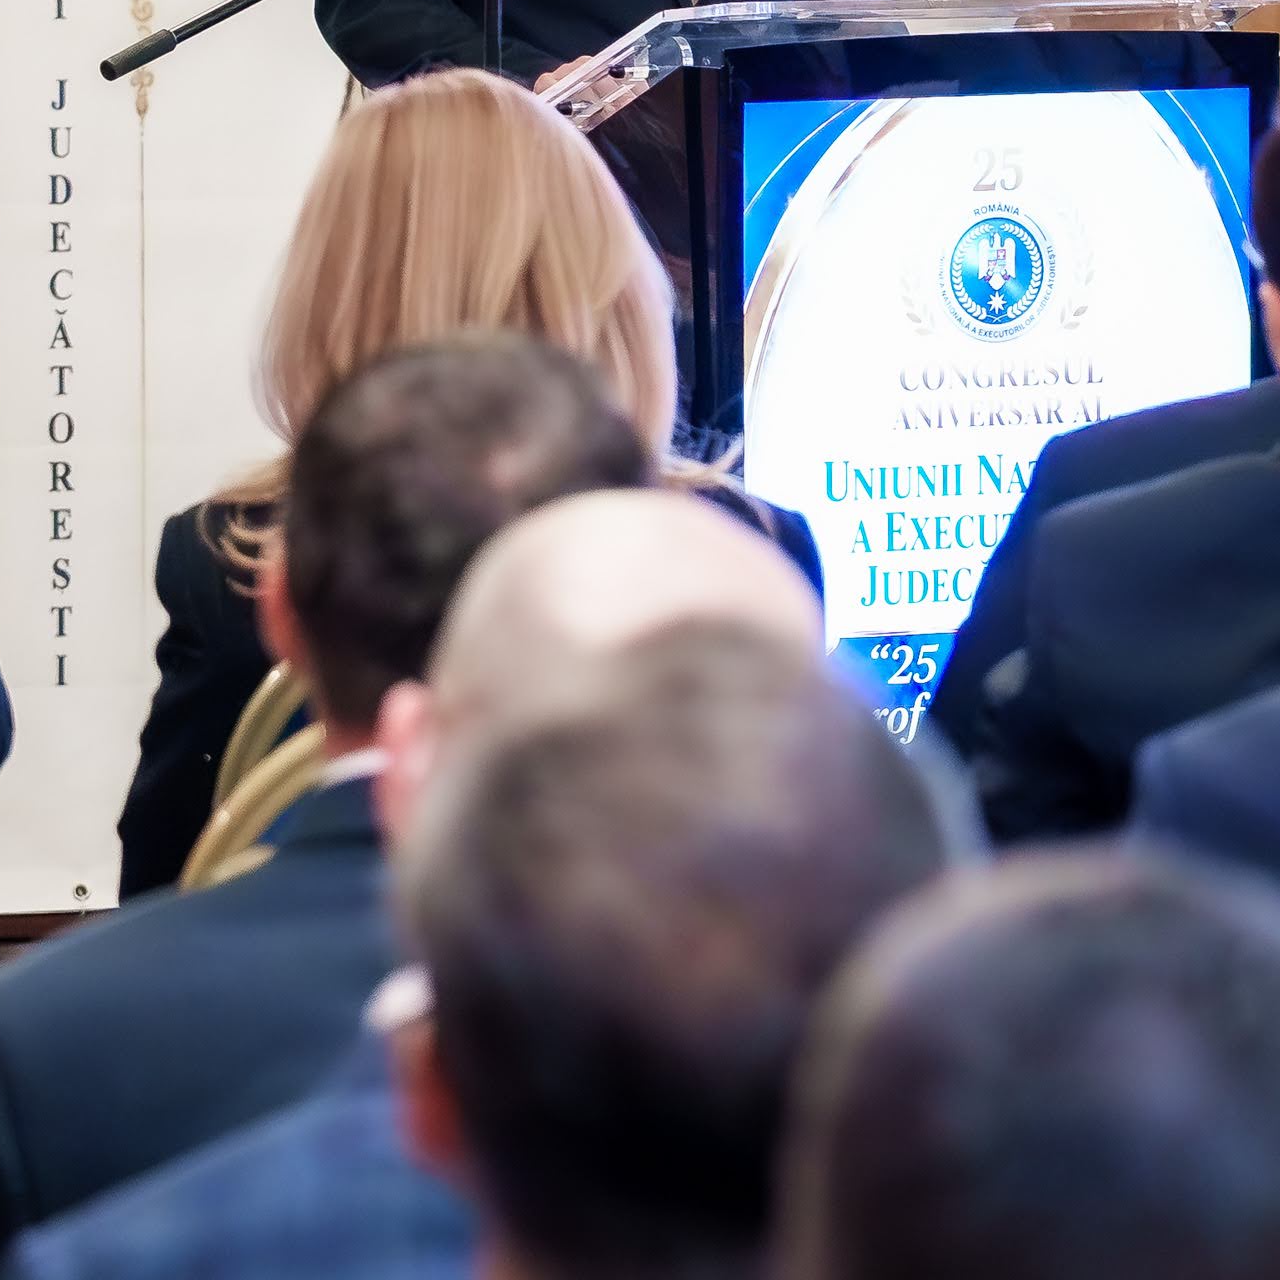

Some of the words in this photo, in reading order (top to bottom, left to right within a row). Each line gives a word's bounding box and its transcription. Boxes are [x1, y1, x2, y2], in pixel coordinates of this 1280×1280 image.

[973, 147, 1024, 191] 25
[899, 354, 1103, 392] CONGRESUL
[893, 397, 1064, 431] ANIVERSAR
[1072, 395, 1112, 423] AL
[824, 461, 963, 502] UNIUNII
[860, 560, 988, 607] JUDEC
[870, 643, 939, 685] “25
